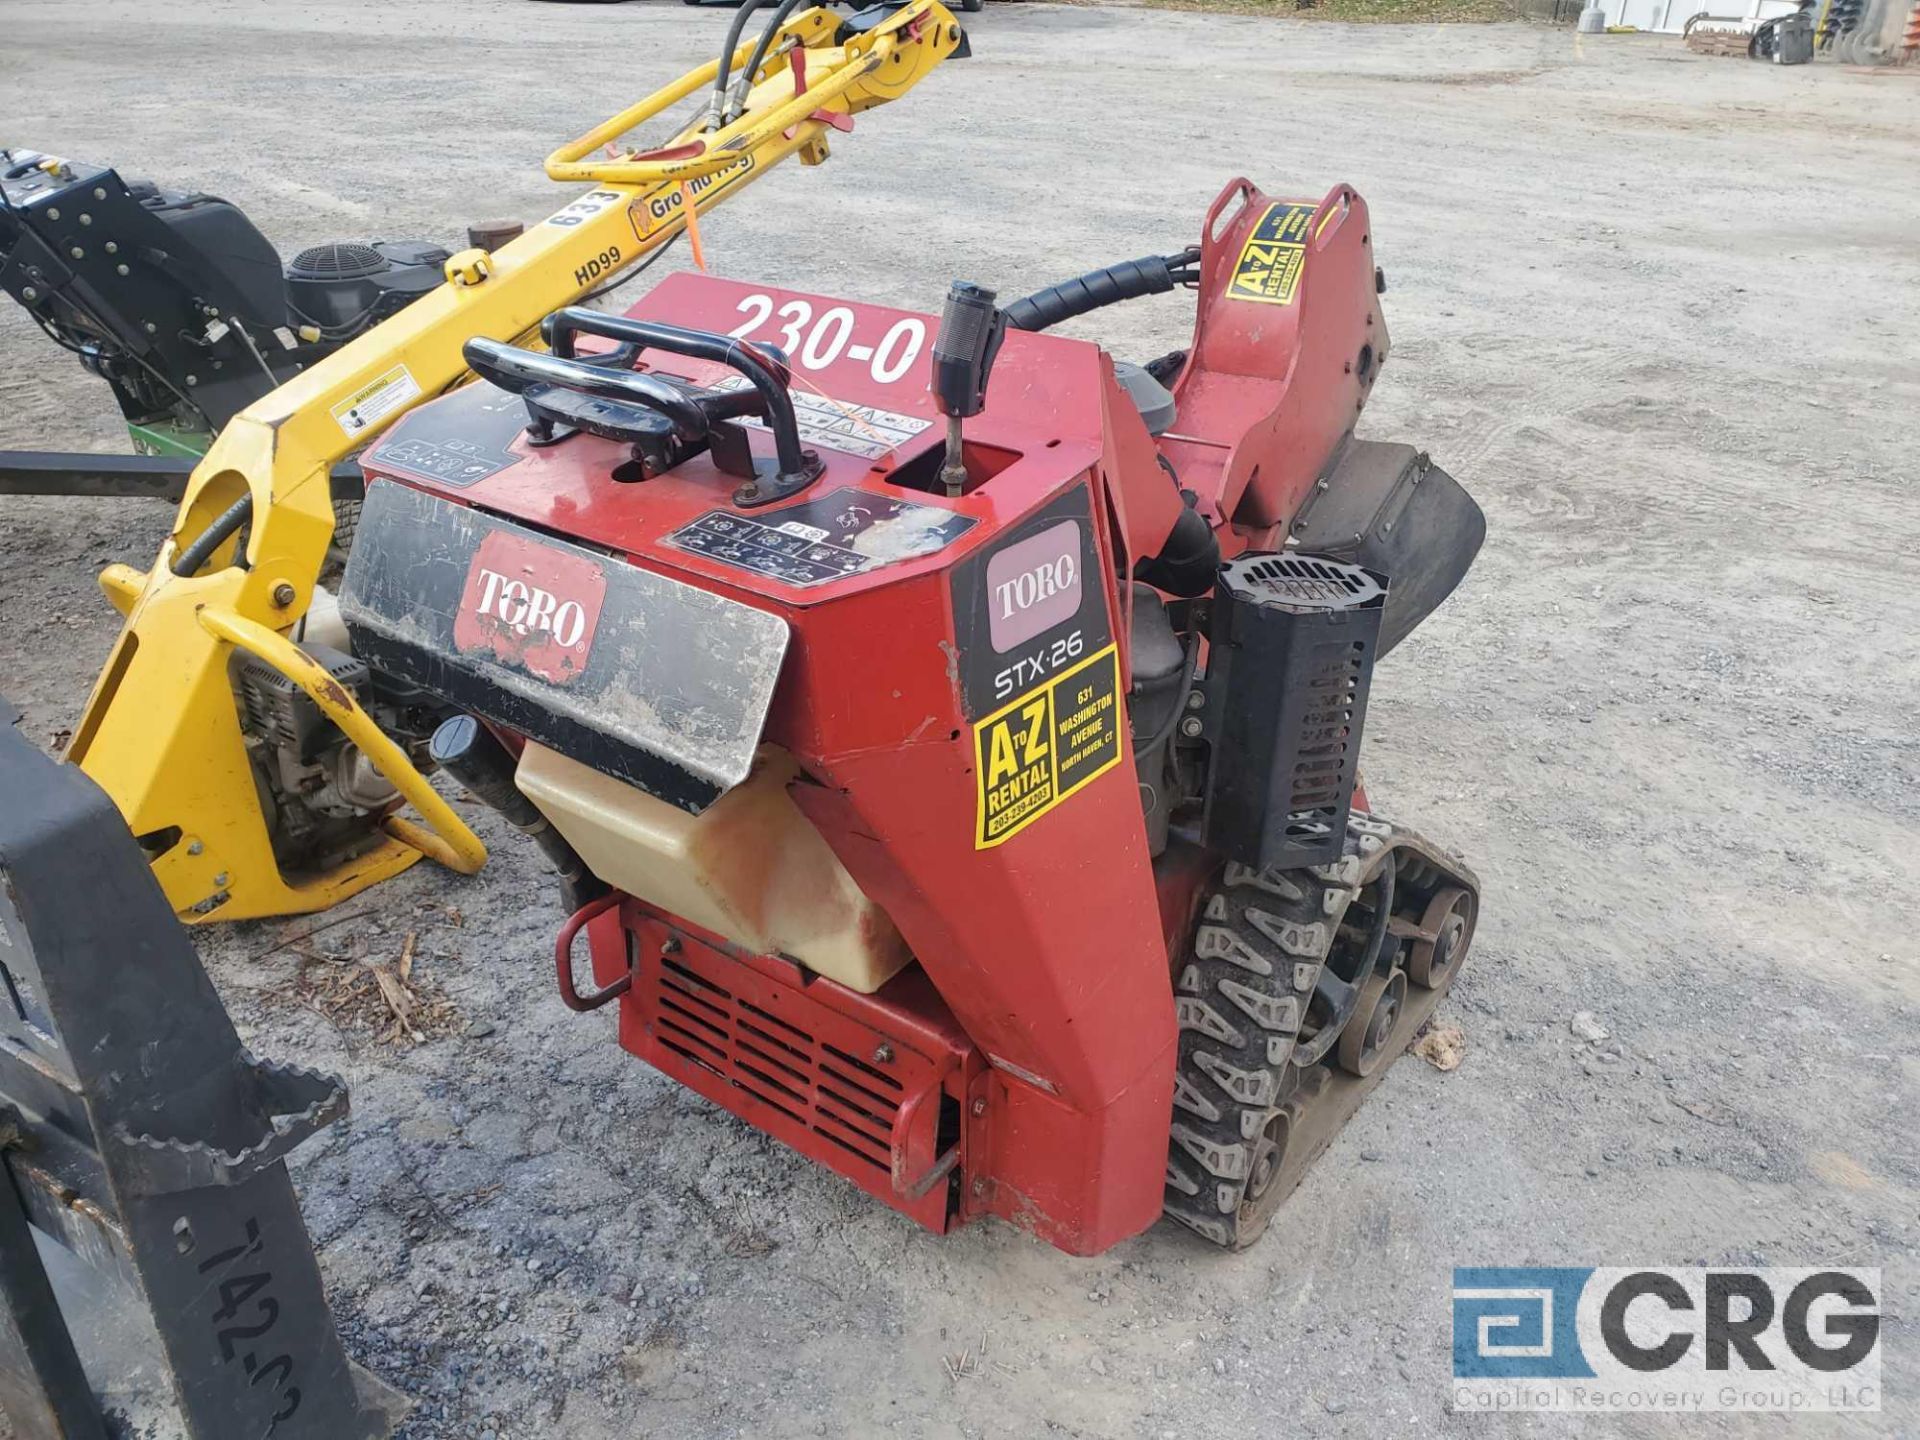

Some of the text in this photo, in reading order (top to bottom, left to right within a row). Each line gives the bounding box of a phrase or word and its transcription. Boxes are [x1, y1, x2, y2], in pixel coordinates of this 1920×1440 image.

[548, 192, 620, 227] 633
[574, 246, 621, 286] HD99
[1236, 245, 1279, 295] A TO Z
[1264, 249, 1293, 296] RENTAL
[996, 554, 1074, 620] TORO
[1059, 692, 1112, 736] WASHINGTON
[1077, 685, 1093, 705] 631
[988, 697, 1048, 790] A TO Z
[1061, 752, 1082, 772] NORTH
[1105, 731, 1113, 743] CT
[1071, 717, 1103, 748] AVENUE
[988, 760, 1049, 816] RENTAL
[993, 787, 1048, 831] 203-239-4203
